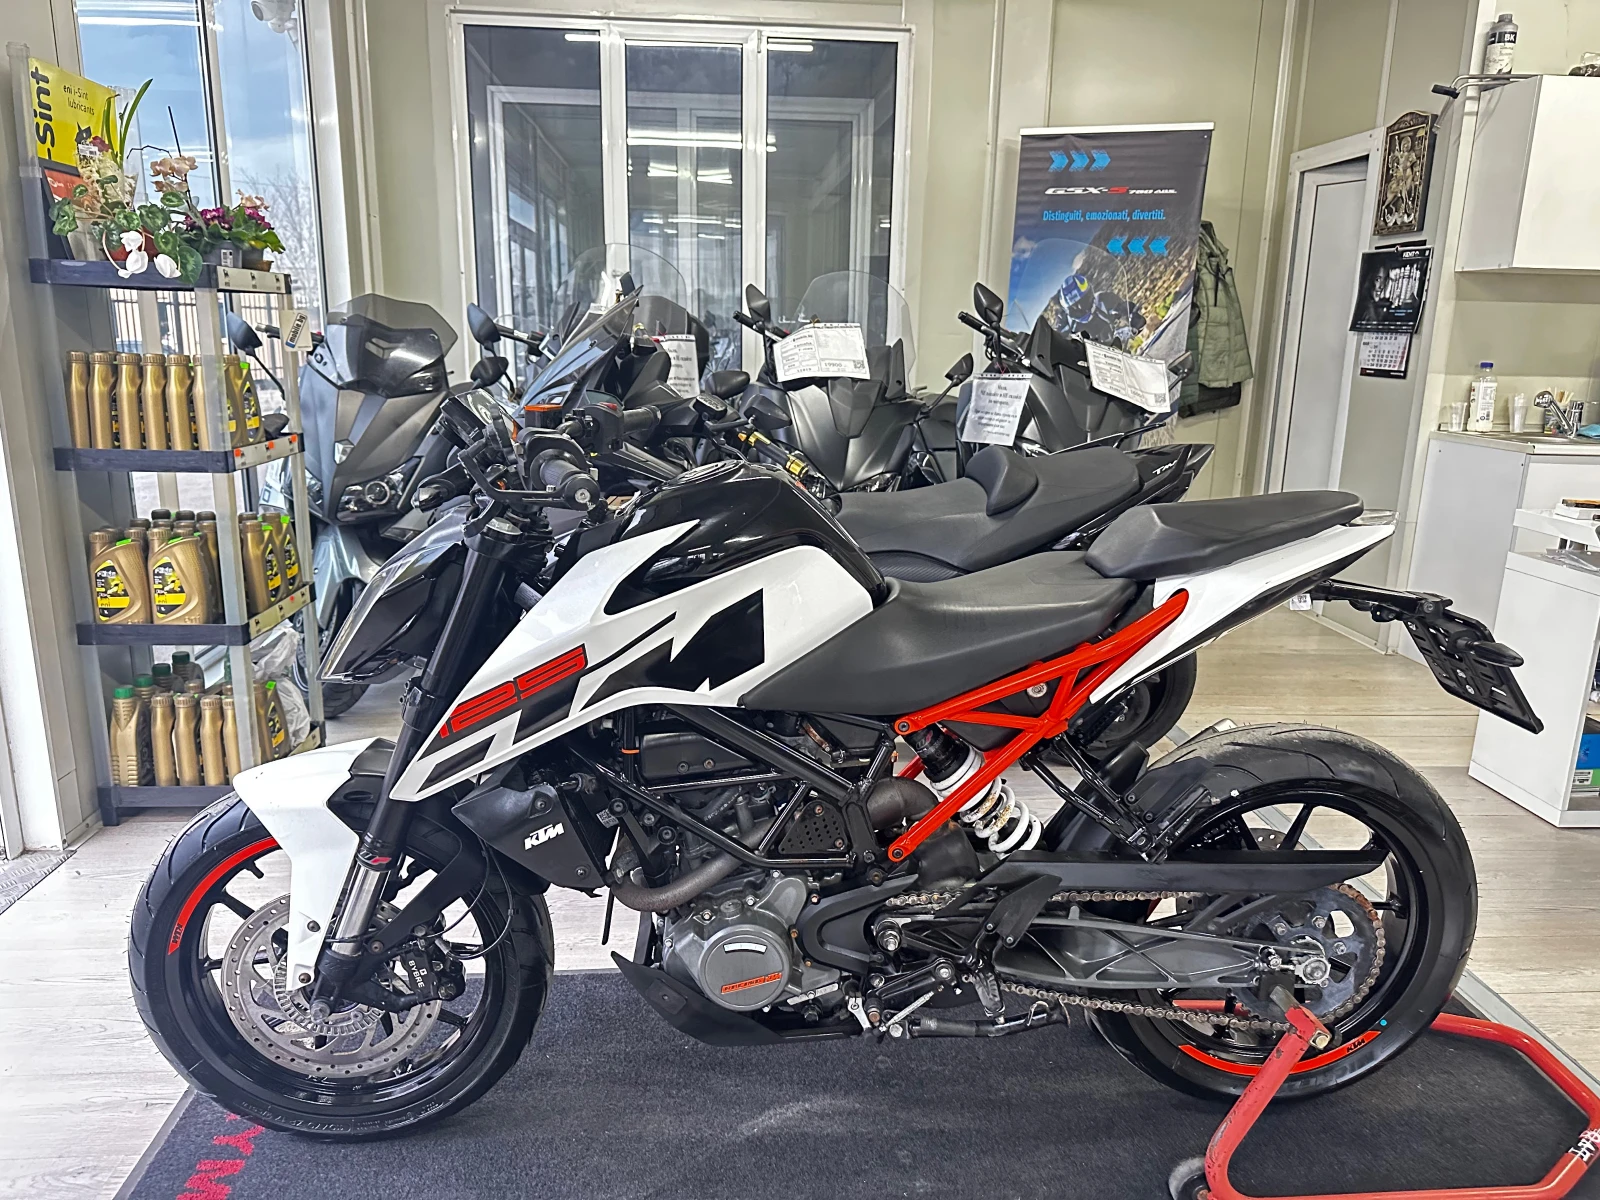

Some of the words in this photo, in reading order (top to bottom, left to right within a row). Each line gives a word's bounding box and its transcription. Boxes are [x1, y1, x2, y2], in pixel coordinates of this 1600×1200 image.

[63, 84, 73, 95] eni
[67, 97, 95, 116] lubricants
[1042, 210, 1084, 223] Distinguiti,
[1085, 209, 1130, 222] emozionati,
[1131, 208, 1166, 221] divertiti.
[438, 645, 587, 739] 125
[524, 822, 565, 851] KTM
[171, 922, 183, 944] KTM
[408, 959, 425, 988] BYBRE
[1346, 1038, 1366, 1054] KTM
